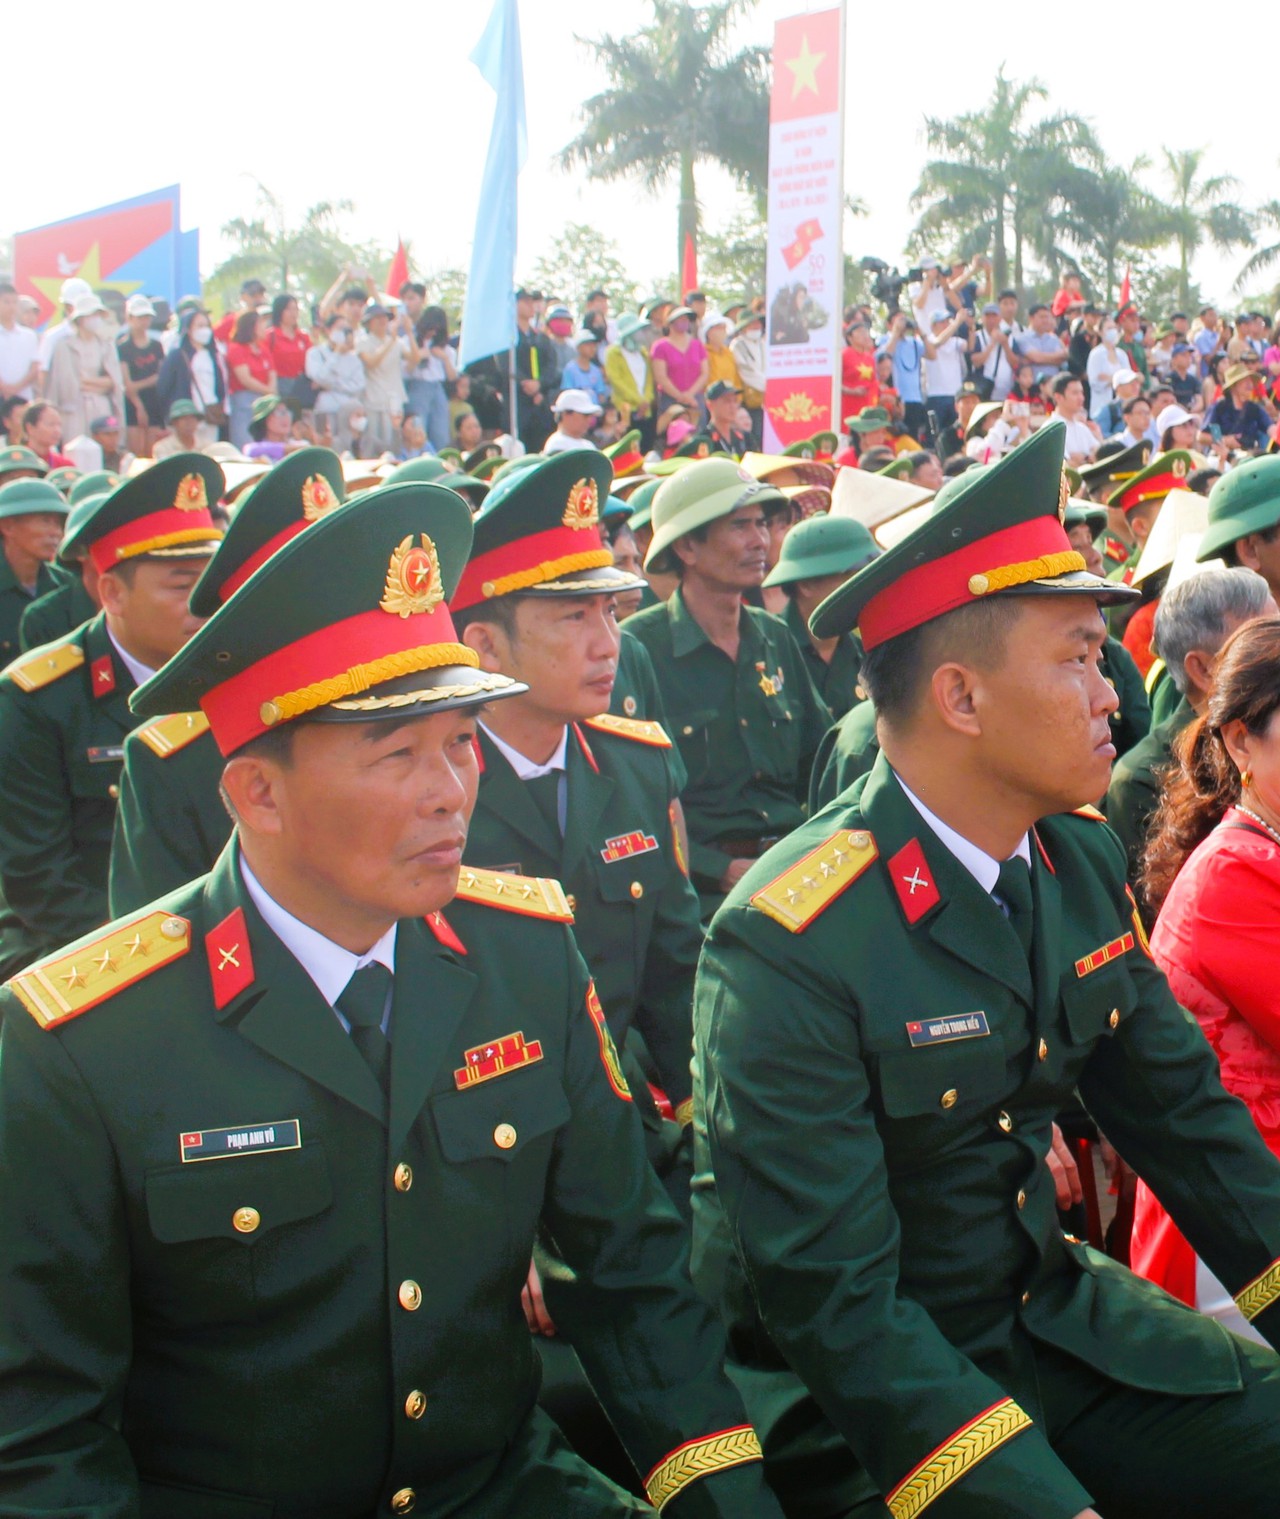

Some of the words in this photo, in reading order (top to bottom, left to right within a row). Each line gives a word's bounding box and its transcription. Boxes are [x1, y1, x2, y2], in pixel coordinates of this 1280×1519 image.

[227, 1132, 249, 1149] PHẠM
[249, 1130, 265, 1146] ANH
[264, 1127, 275, 1143] VŨ
